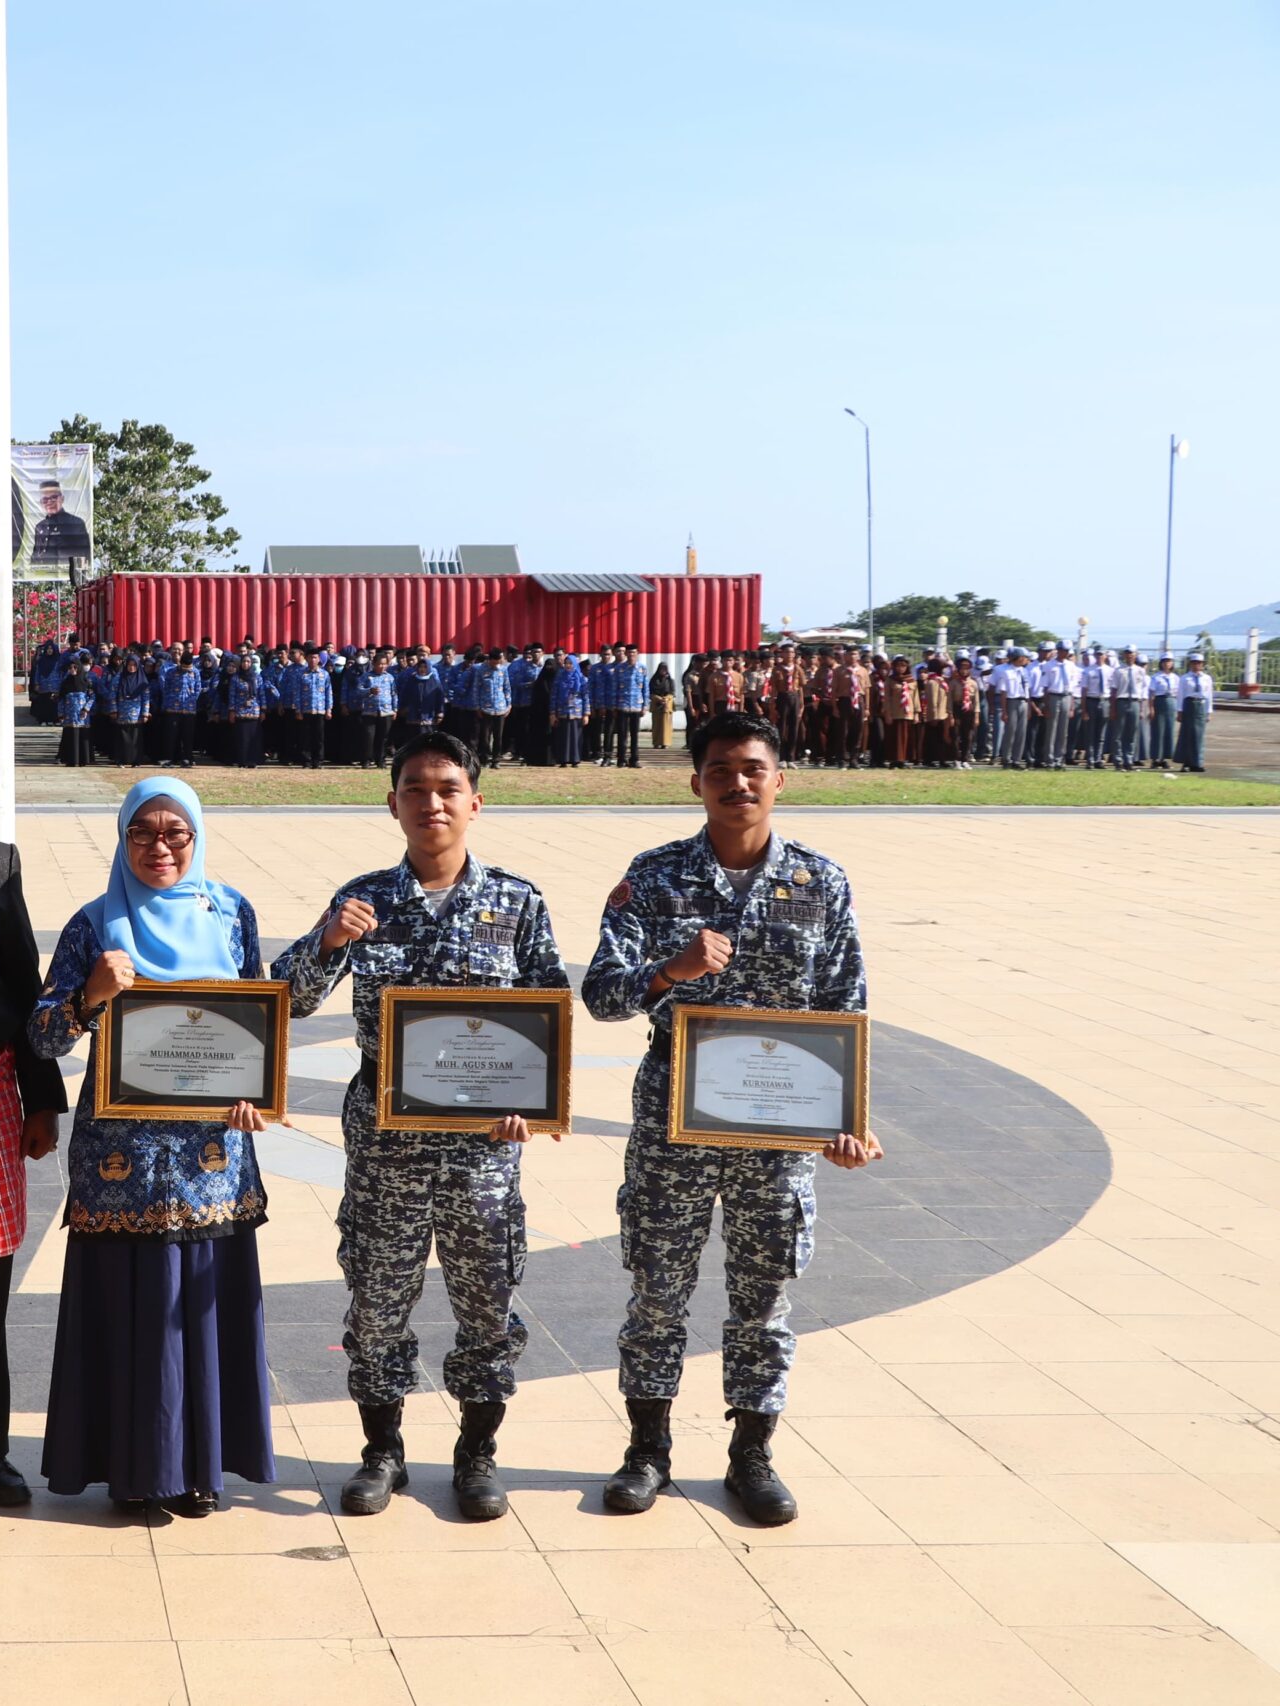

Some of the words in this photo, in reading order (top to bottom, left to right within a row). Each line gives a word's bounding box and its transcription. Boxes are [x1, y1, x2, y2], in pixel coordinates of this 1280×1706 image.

[150, 1050, 201, 1059] MUHAMMAD
[203, 1052, 235, 1060] SAHRUL
[435, 1060, 459, 1069] MUH.
[463, 1061, 486, 1069] AGUS
[488, 1061, 513, 1070] SYAM
[742, 1079, 794, 1089] KURNIAWAN
